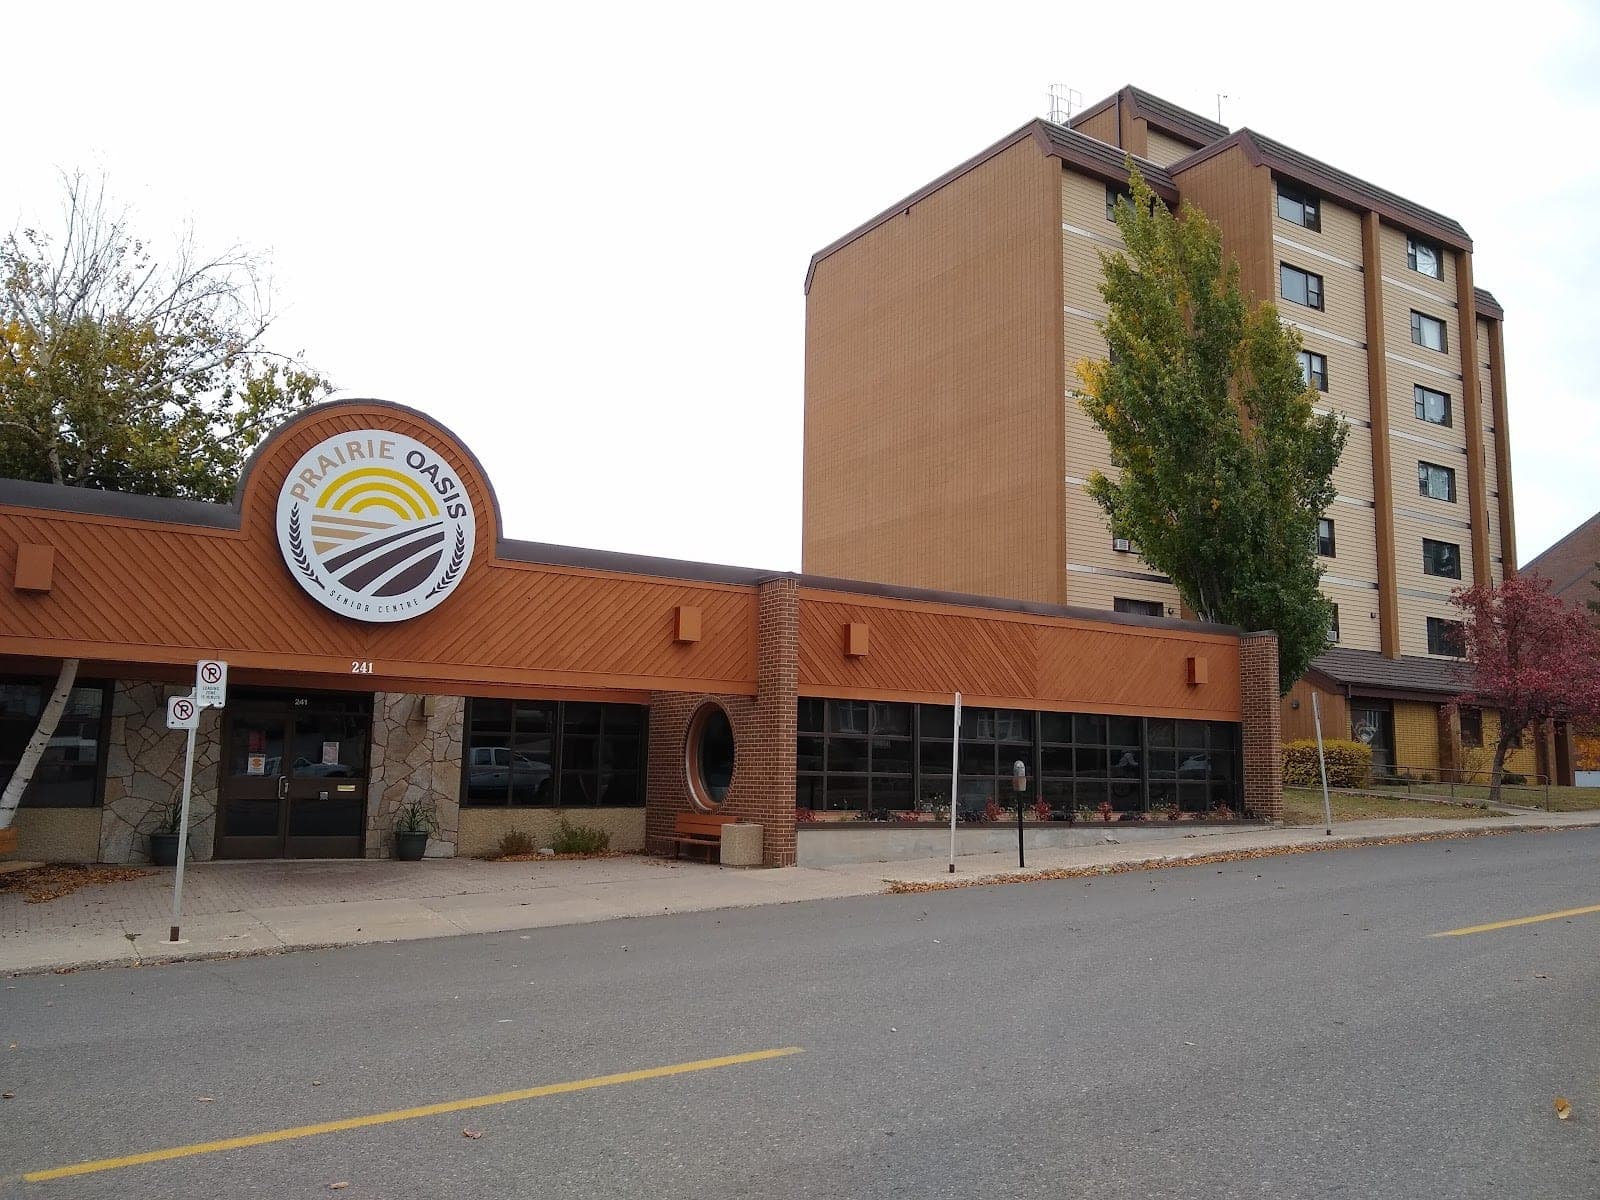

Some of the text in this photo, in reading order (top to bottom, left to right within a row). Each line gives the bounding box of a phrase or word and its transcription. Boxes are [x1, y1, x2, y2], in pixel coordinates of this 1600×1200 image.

[290, 439, 467, 519] PRAIRIE OASIS
[329, 589, 419, 613] SENIOR CENTRE
[351, 661, 374, 674] 241
[294, 698, 308, 706] 241
